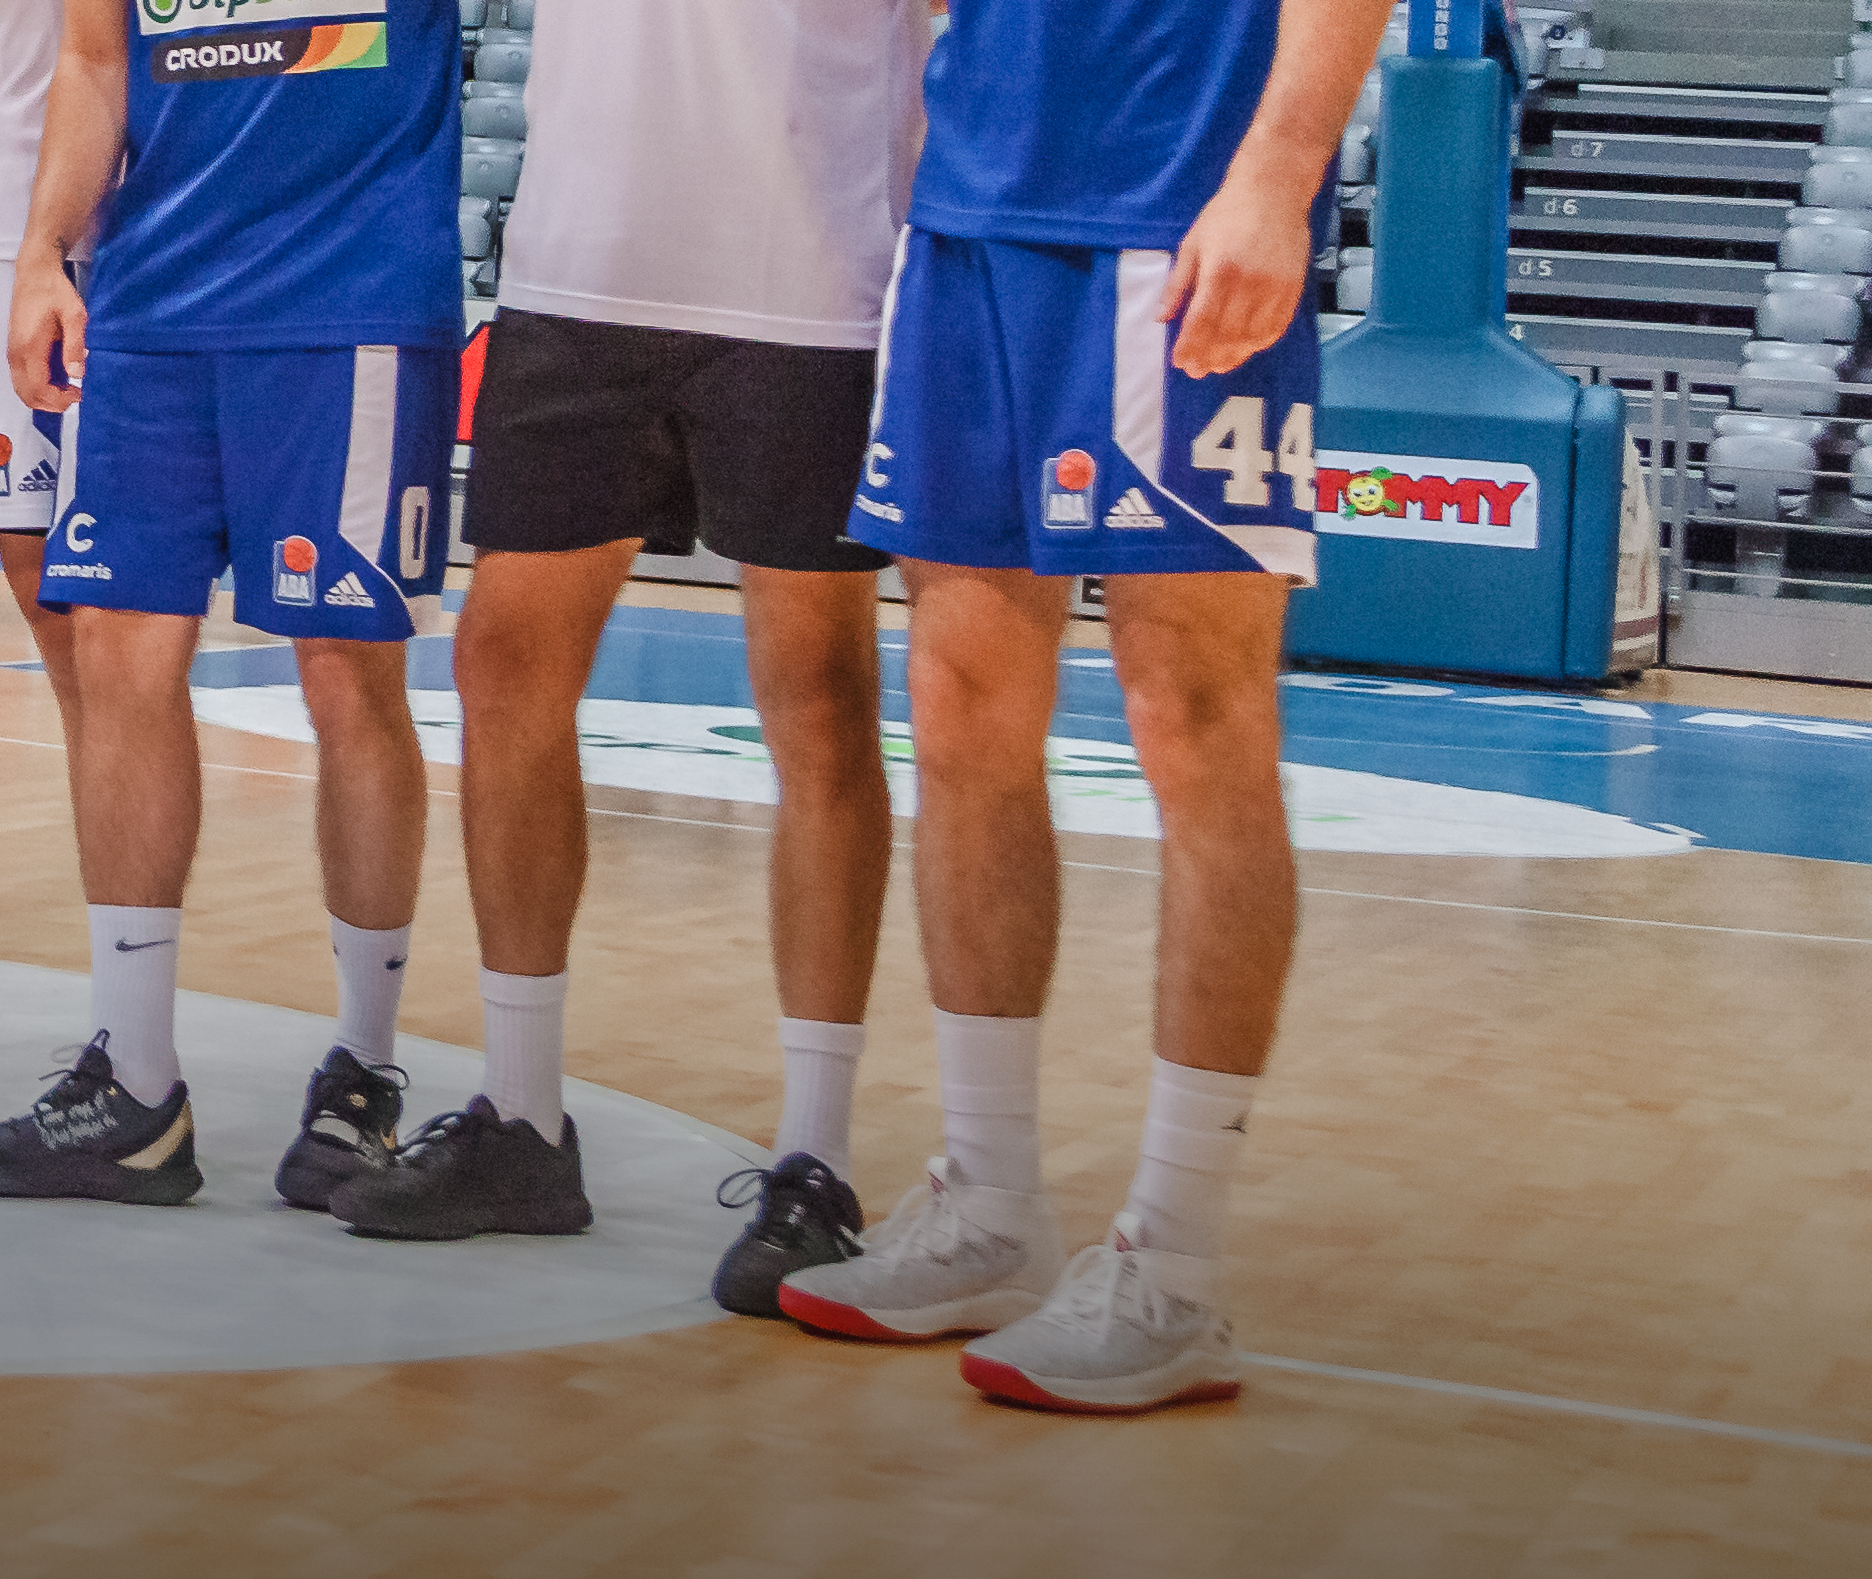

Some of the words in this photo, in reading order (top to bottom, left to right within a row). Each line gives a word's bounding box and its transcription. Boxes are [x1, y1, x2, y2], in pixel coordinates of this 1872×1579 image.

[164, 40, 284, 72] CRODUX
[1191, 395, 1316, 512] 44
[1315, 465, 1531, 528] TOMMY
